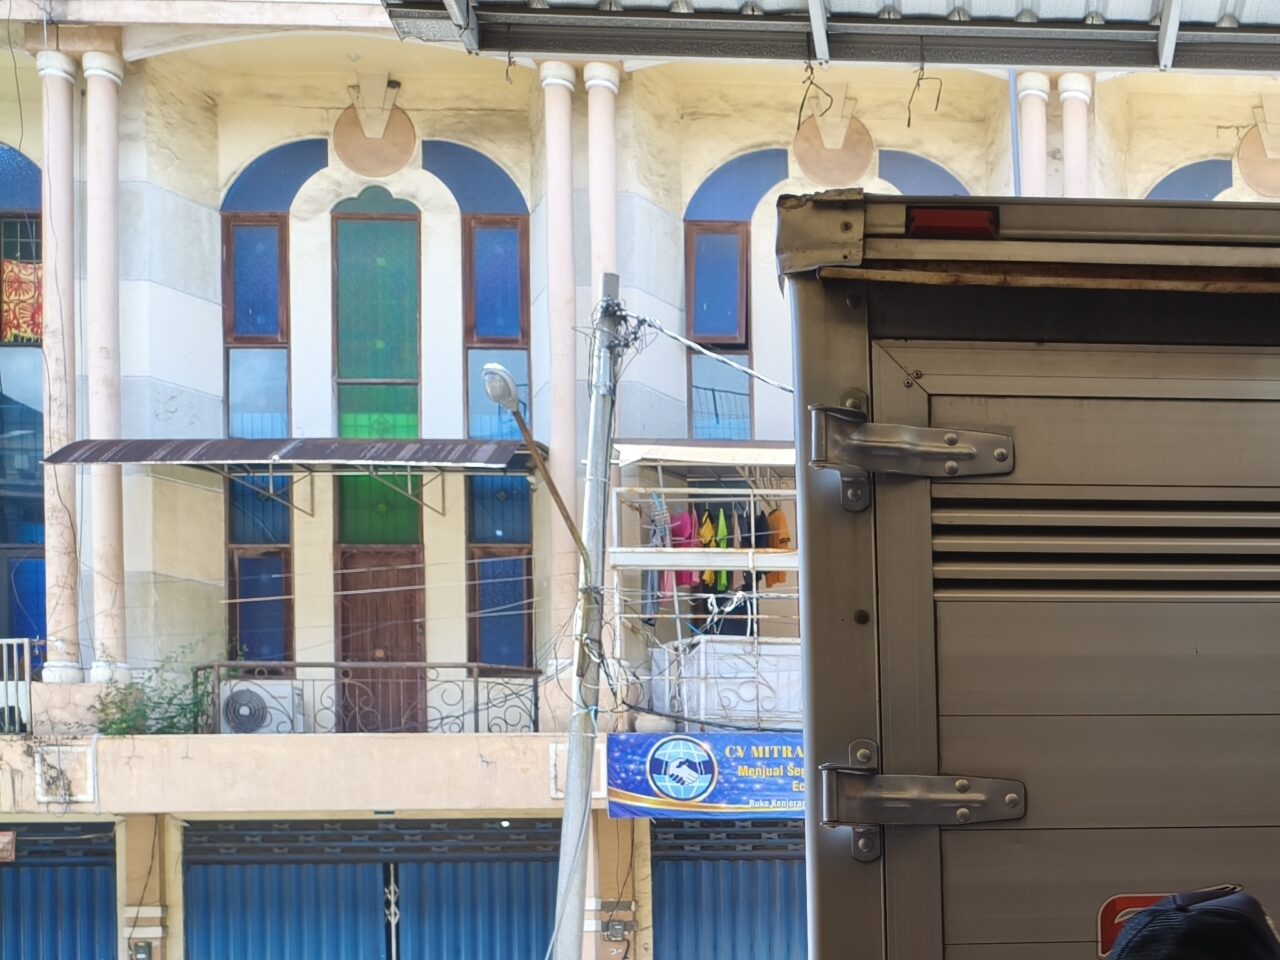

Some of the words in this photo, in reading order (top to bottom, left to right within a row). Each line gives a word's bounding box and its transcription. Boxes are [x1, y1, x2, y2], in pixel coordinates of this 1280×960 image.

[725, 745, 747, 758] CV
[751, 745, 805, 758] MITRA
[737, 765, 783, 778] Menjual
